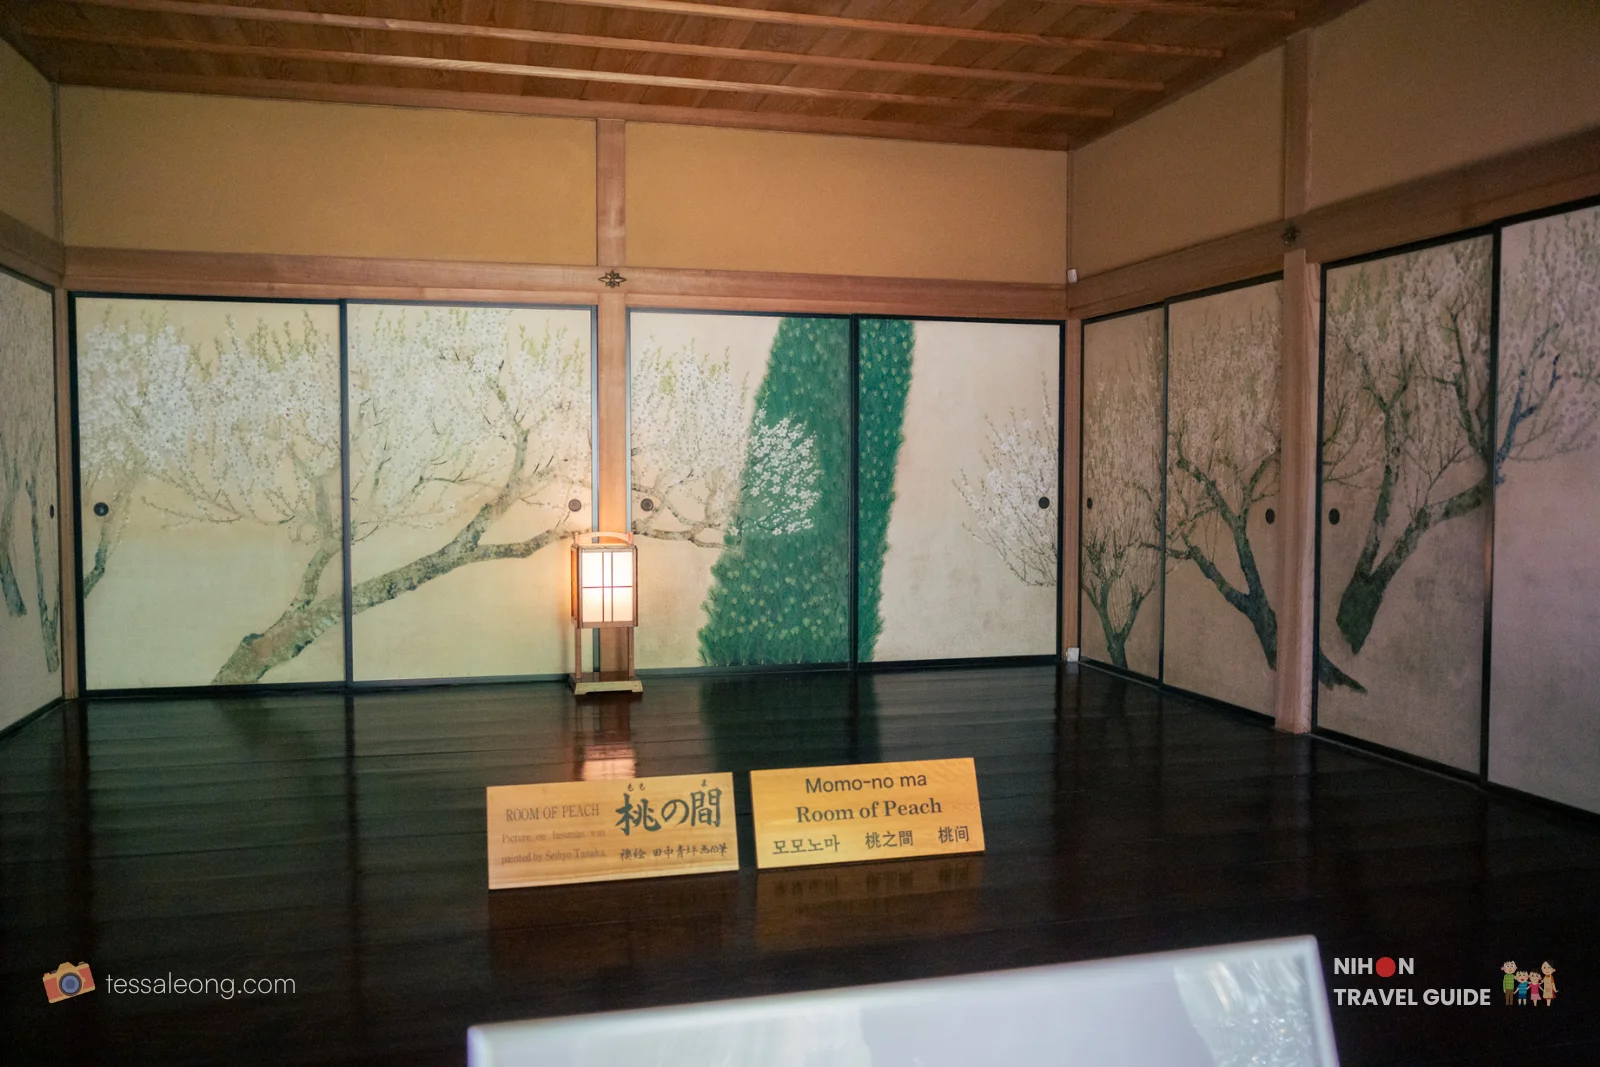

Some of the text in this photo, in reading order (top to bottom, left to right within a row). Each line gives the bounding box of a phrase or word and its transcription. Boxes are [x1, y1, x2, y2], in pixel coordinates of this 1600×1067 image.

[805, 774, 927, 794] Momo-no ma
[505, 803, 600, 822] ROOM OF PEACH
[615, 787, 722, 836] 桃の間
[795, 797, 943, 823] Room of Peach
[865, 830, 914, 850] 桃之間
[937, 825, 970, 844] 桃间
[772, 834, 841, 856] 모모노마
[501, 852, 531, 865] painted
[533, 852, 542, 863] by
[573, 847, 606, 859] Tanaka
